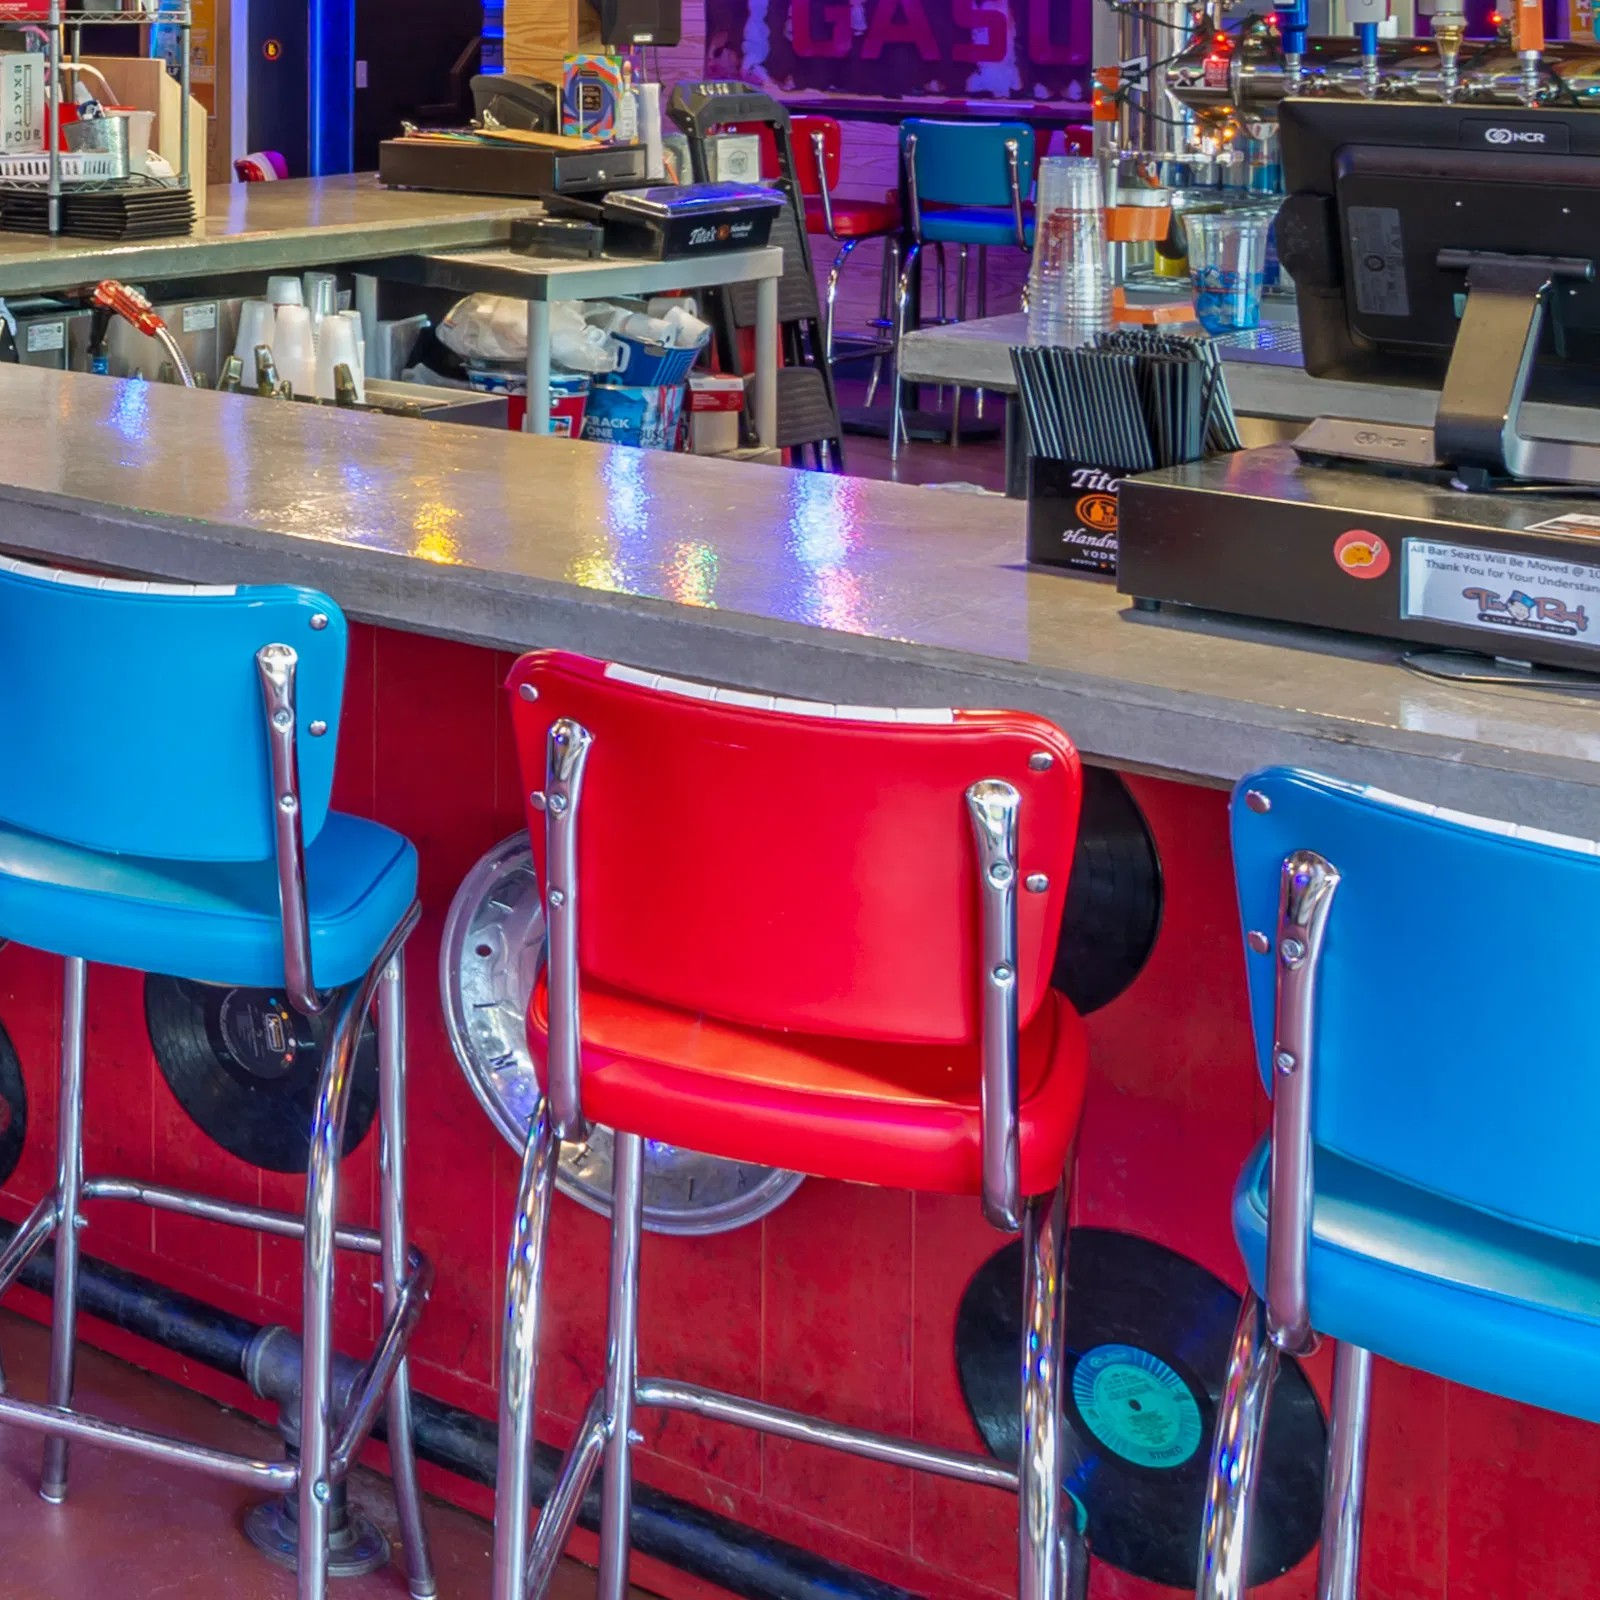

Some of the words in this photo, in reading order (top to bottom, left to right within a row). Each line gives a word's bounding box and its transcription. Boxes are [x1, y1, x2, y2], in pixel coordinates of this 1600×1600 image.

[1513, 131, 1546, 143] NCR
[1411, 545, 1425, 555] All
[1428, 546, 1449, 557] Bar
[1450, 548, 1482, 562] Seats
[1484, 551, 1507, 565] Will
[1509, 557, 1525, 568] Be
[1526, 559, 1569, 575] Moved
[1572, 565, 1586, 577] @
[1425, 558, 1460, 573] Thank
[1462, 563, 1485, 577] You
[1488, 567, 1504, 579] for
[1507, 571, 1535, 585] Your
[1462, 586, 1508, 613] Tin
[1533, 595, 1590, 633] Roof
